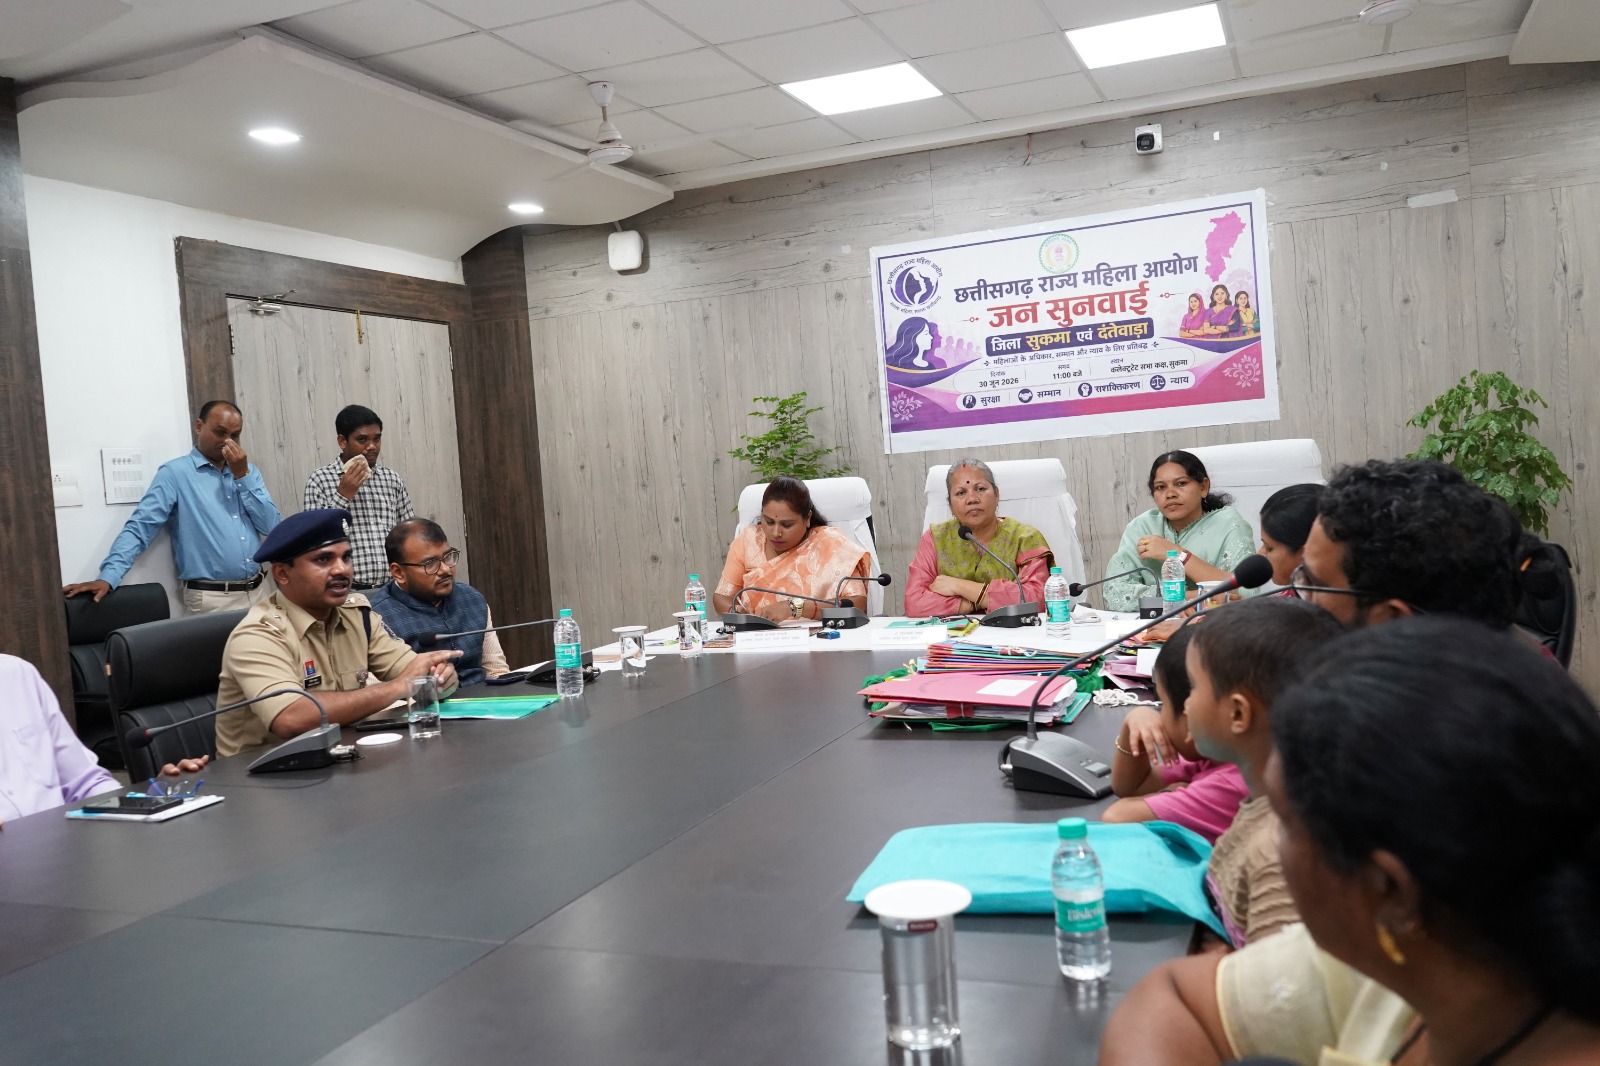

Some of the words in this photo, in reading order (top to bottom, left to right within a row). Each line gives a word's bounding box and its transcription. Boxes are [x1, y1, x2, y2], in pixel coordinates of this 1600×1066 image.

[954, 279, 1033, 303] छत्तीसगढ़
[1038, 272, 1078, 292] राज्य
[1082, 262, 1137, 286] महिला
[1143, 253, 1198, 278] आयोग
[987, 302, 1040, 327] जन
[1045, 281, 1149, 327] सुनवाई
[991, 337, 1021, 351] जिला
[1026, 331, 1071, 350] सुकमा
[1076, 328, 1093, 342] एवं
[1097, 322, 1148, 340] दंतेवाड़ा
[993, 355, 1018, 366] महिलाओं
[1077, 348, 1087, 356] और
[1113, 343, 1124, 351] लिए
[1169, 359, 1187, 369] सुकमा
[989, 380, 999, 388] जून
[1170, 376, 1189, 385] न्याय
[1037, 389, 1061, 398] सम्मान
[980, 395, 1000, 406] सुरक्षा
